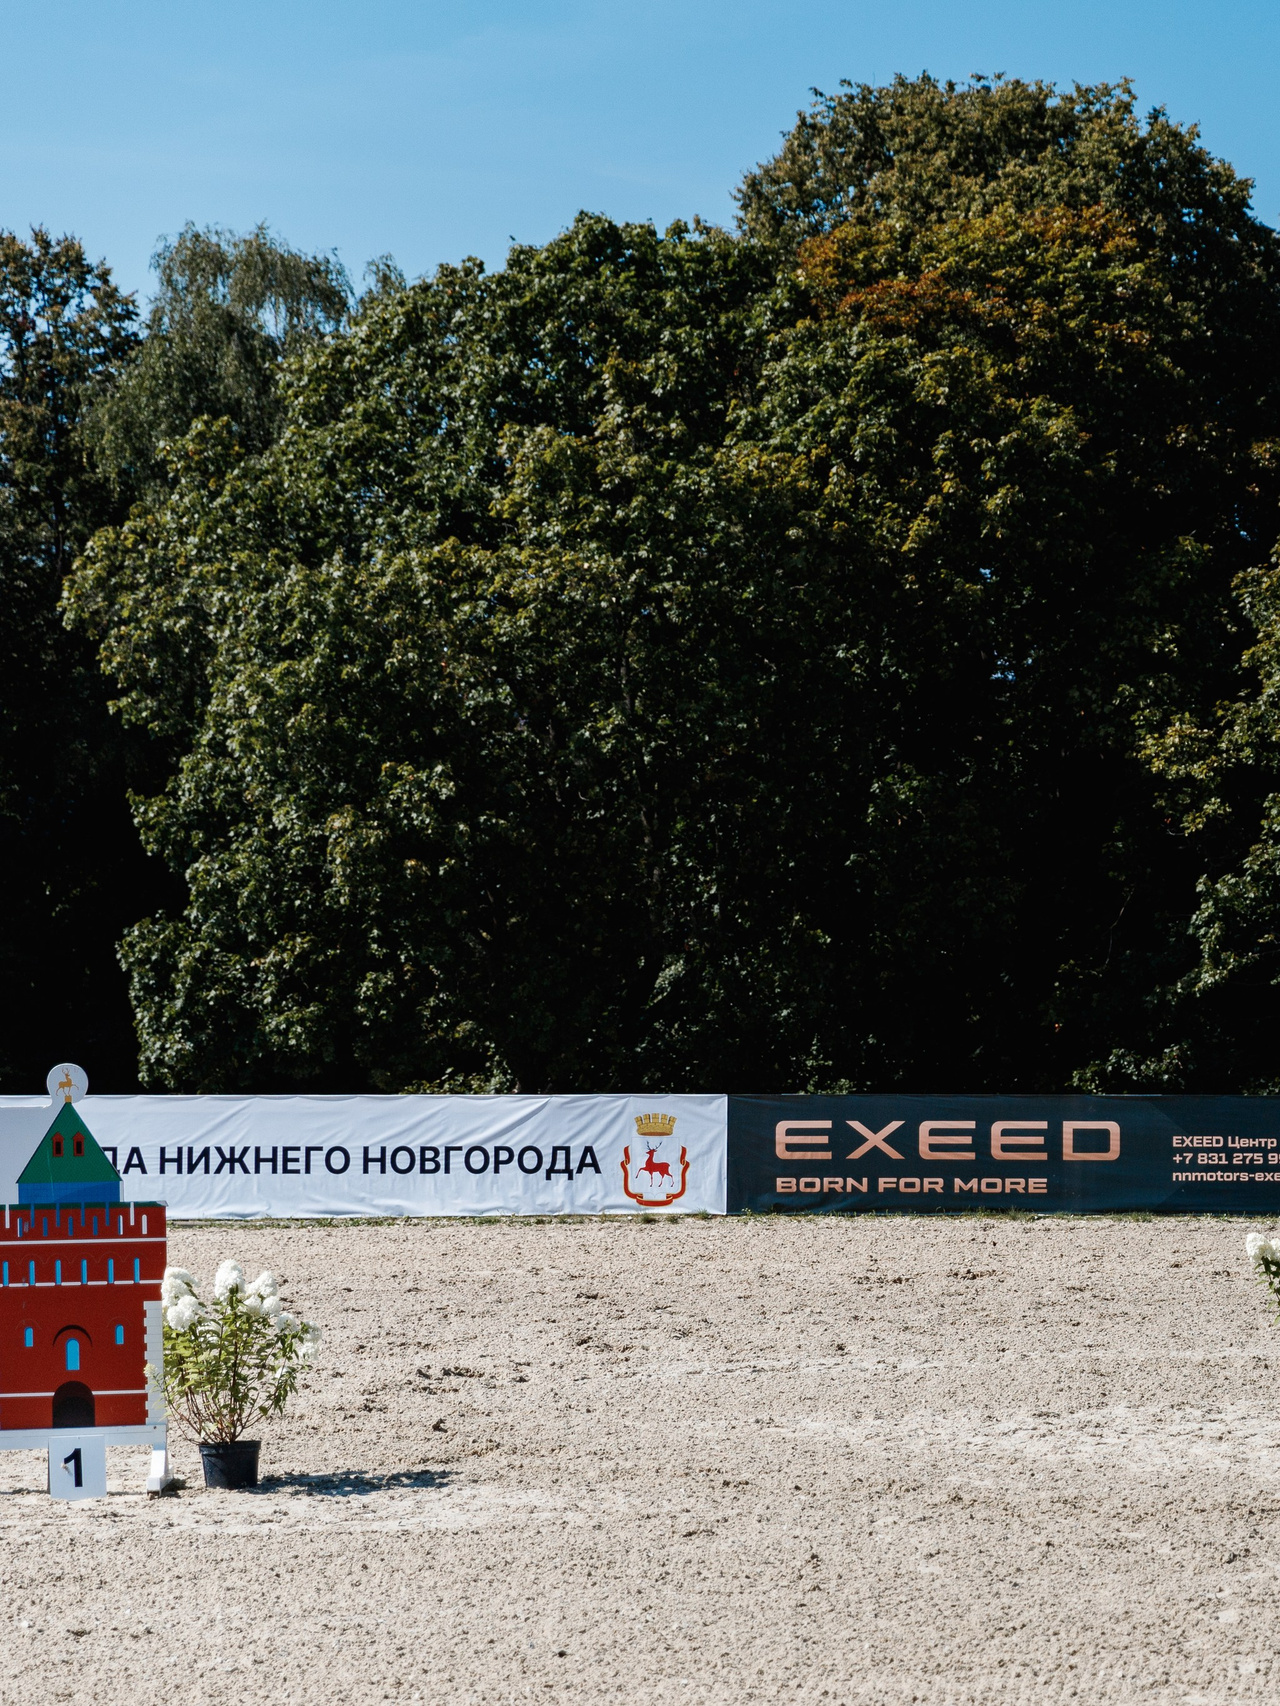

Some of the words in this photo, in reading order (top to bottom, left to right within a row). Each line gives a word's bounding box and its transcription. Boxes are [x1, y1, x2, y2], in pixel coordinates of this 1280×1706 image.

[775, 1120, 1122, 1161] EXEED
[1172, 1136, 1224, 1148] EXEED
[1227, 1136, 1277, 1150] Центр
[159, 1145, 351, 1175] НИЖНЕГО
[362, 1145, 602, 1181] НОВГОРОДА
[1172, 1153, 1193, 1165] +7
[1197, 1153, 1229, 1165] 831
[1232, 1153, 1264, 1165] 275
[776, 1177, 868, 1193] BORN
[878, 1177, 944, 1193] FOR
[954, 1177, 1048, 1194] MORE
[63, 1447, 83, 1488] 1
